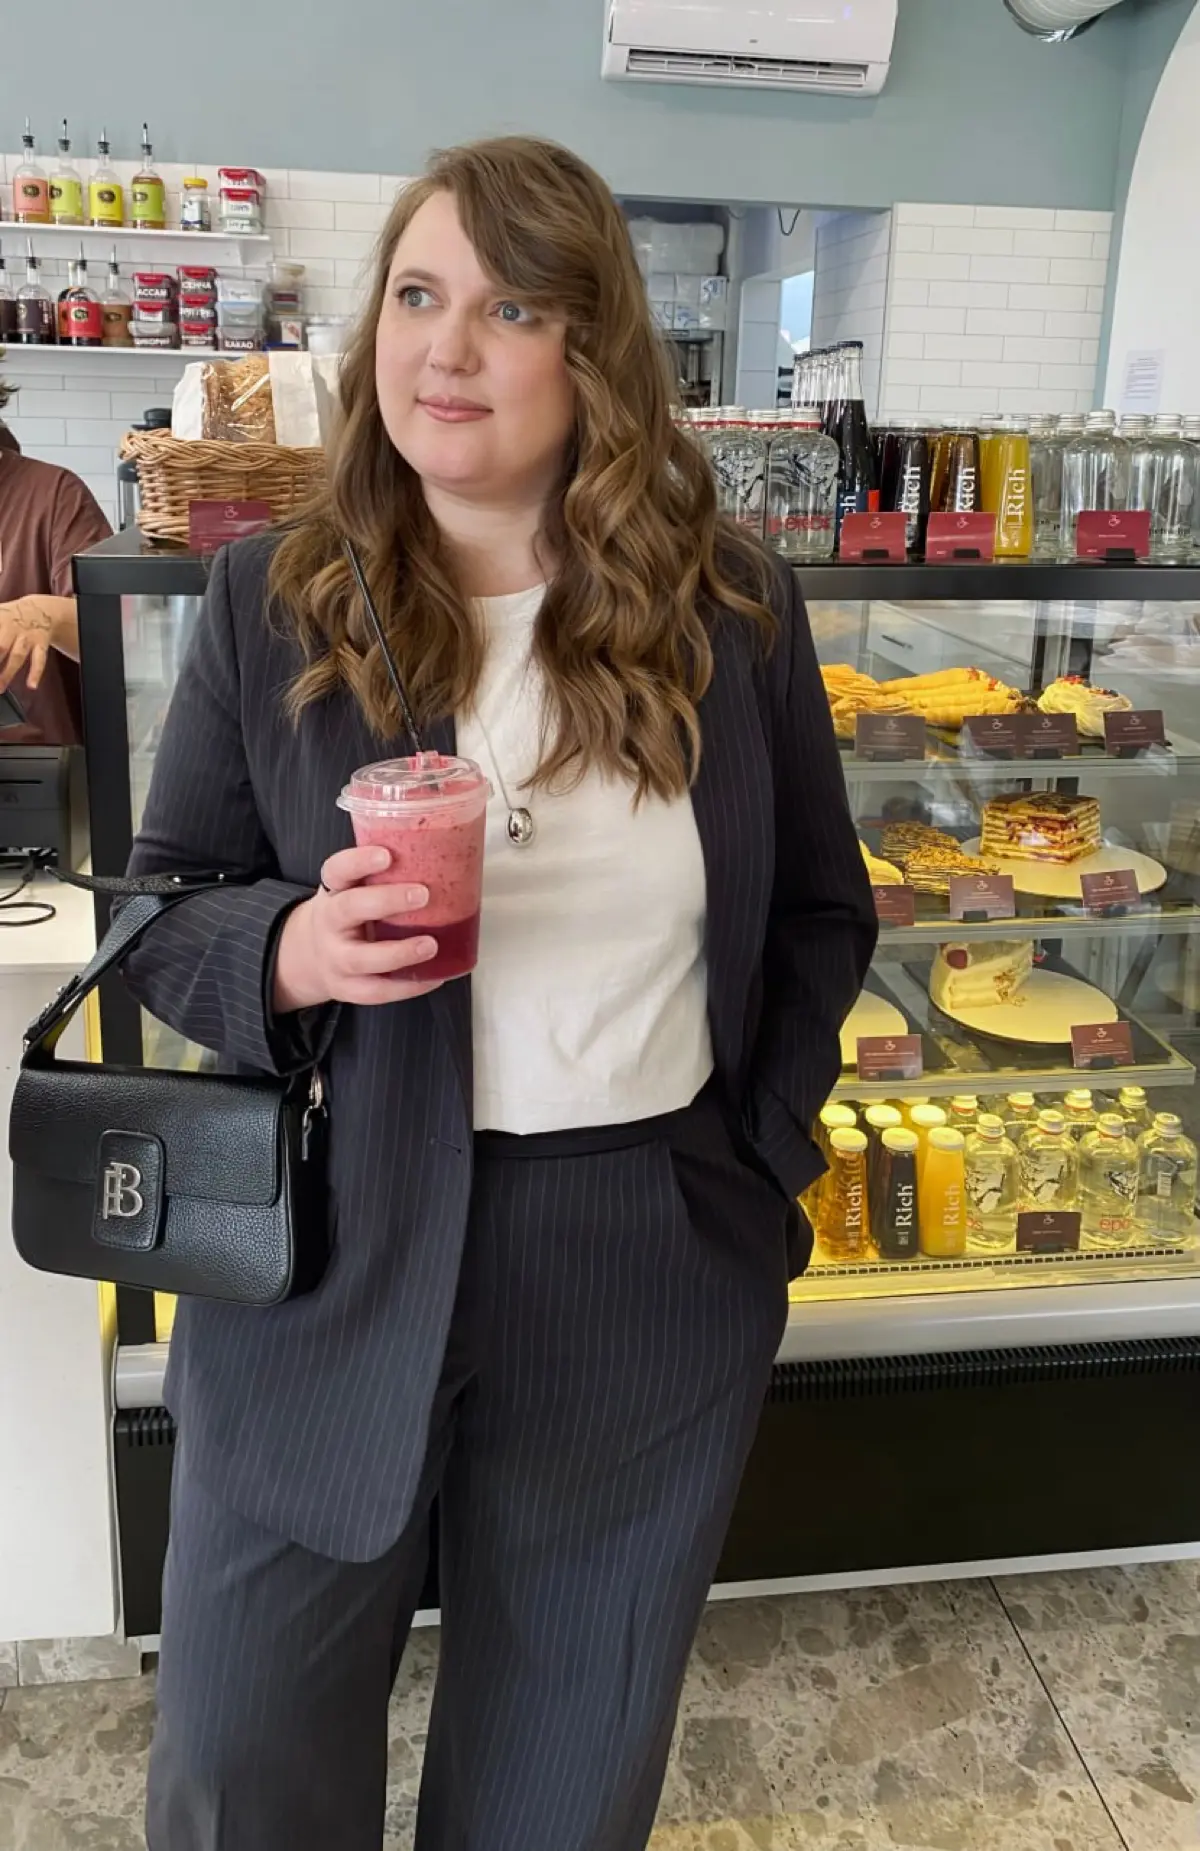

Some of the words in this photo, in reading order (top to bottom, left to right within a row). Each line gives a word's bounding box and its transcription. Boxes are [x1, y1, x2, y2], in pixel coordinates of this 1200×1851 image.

[1007, 468, 1026, 516] Rich
[845, 1184, 863, 1227] Rich
[895, 1184, 914, 1227] Rich
[943, 1184, 961, 1226] Rich
